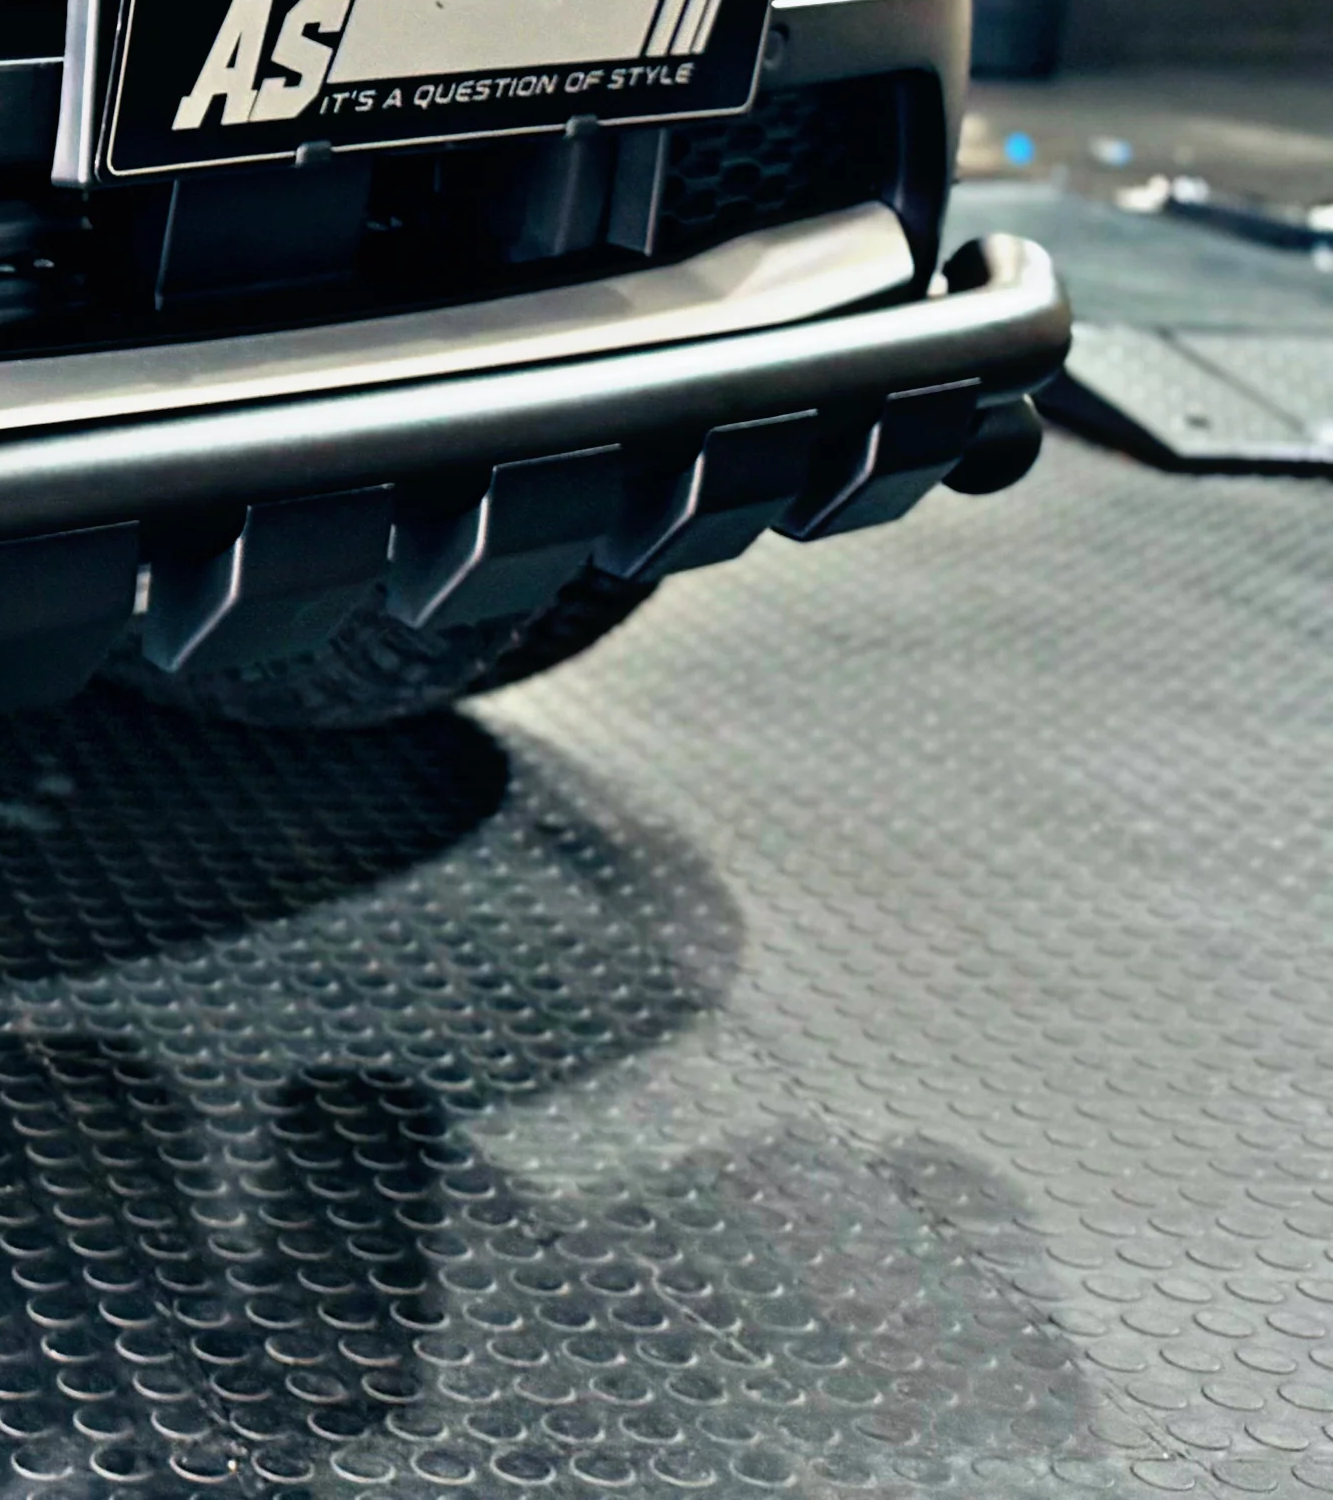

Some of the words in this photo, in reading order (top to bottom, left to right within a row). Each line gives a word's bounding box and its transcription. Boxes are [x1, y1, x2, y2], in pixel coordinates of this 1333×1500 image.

[319, 89, 376, 115] IT'S
[382, 93, 403, 109] A
[412, 73, 560, 110] QUESTION
[564, 68, 605, 94] OF
[606, 62, 695, 91] STYLE
